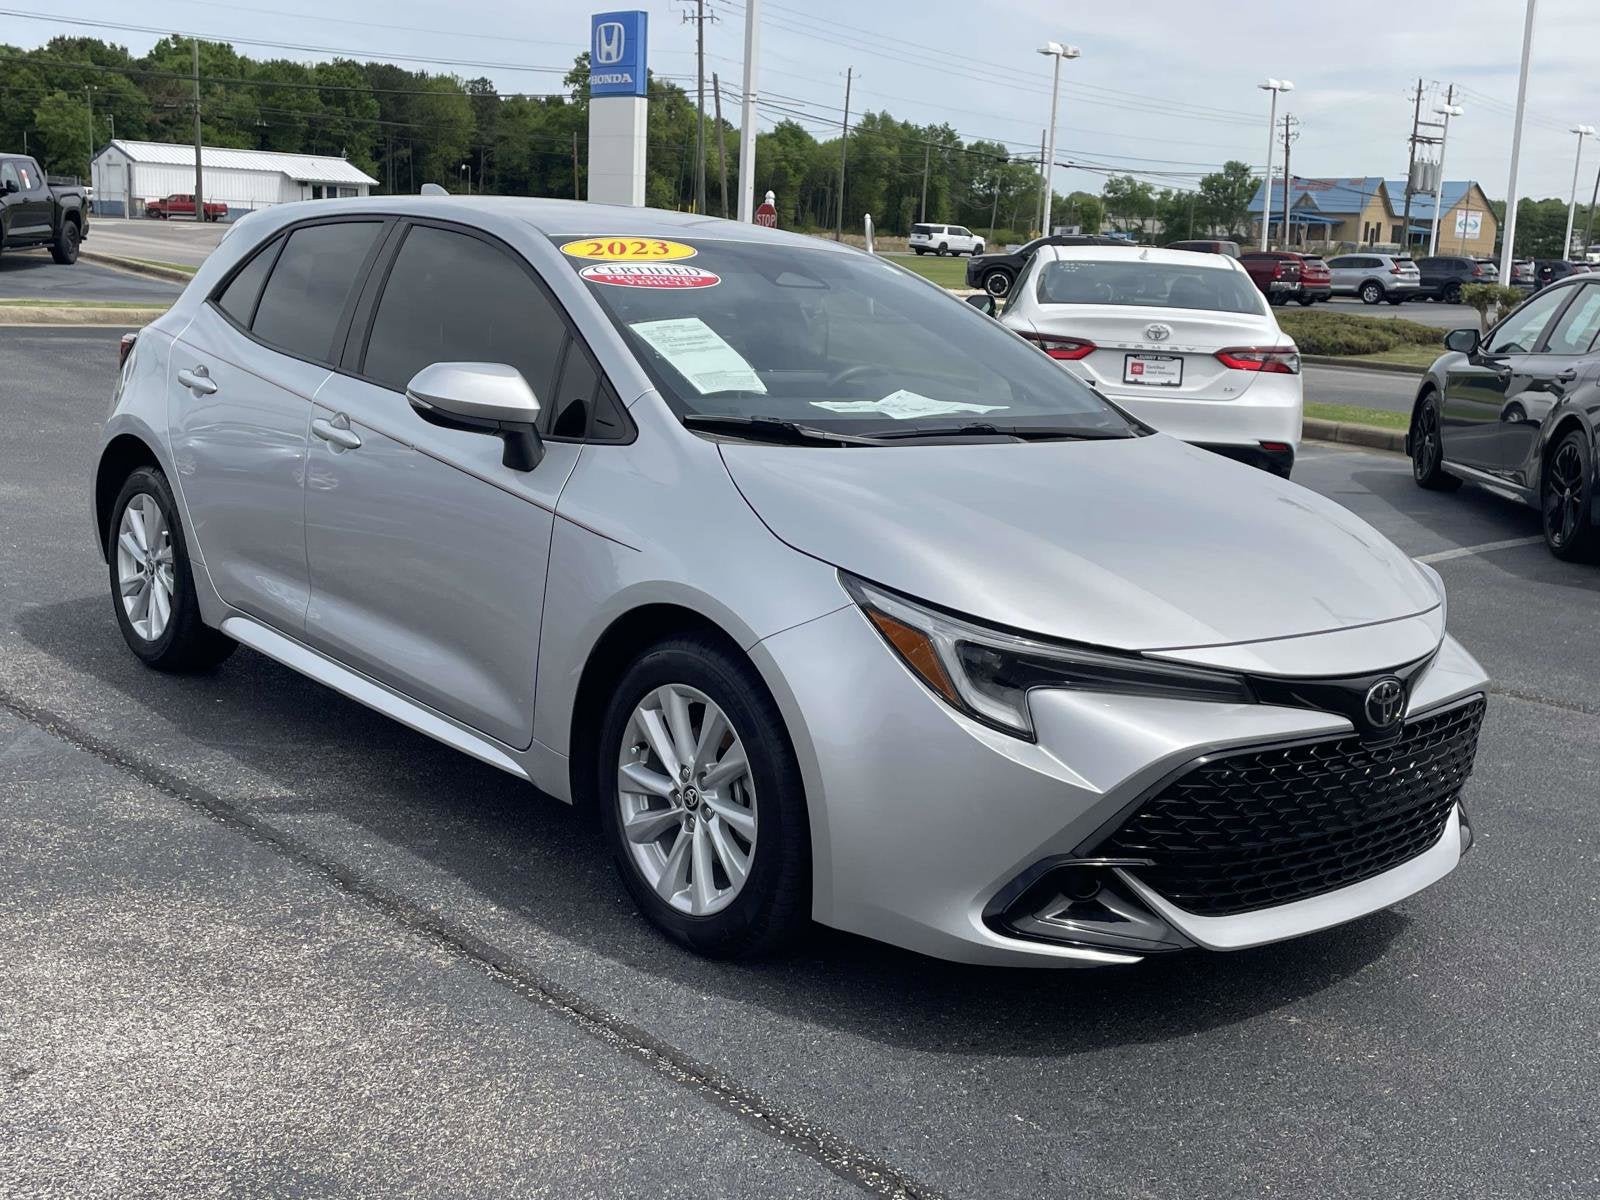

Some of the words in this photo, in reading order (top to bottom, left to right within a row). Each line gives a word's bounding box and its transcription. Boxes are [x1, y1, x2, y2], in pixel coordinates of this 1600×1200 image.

[589, 73, 633, 85] HONDA
[757, 214, 776, 226] STOP
[586, 241, 670, 256] 2023
[593, 266, 701, 276] CERTIFIED
